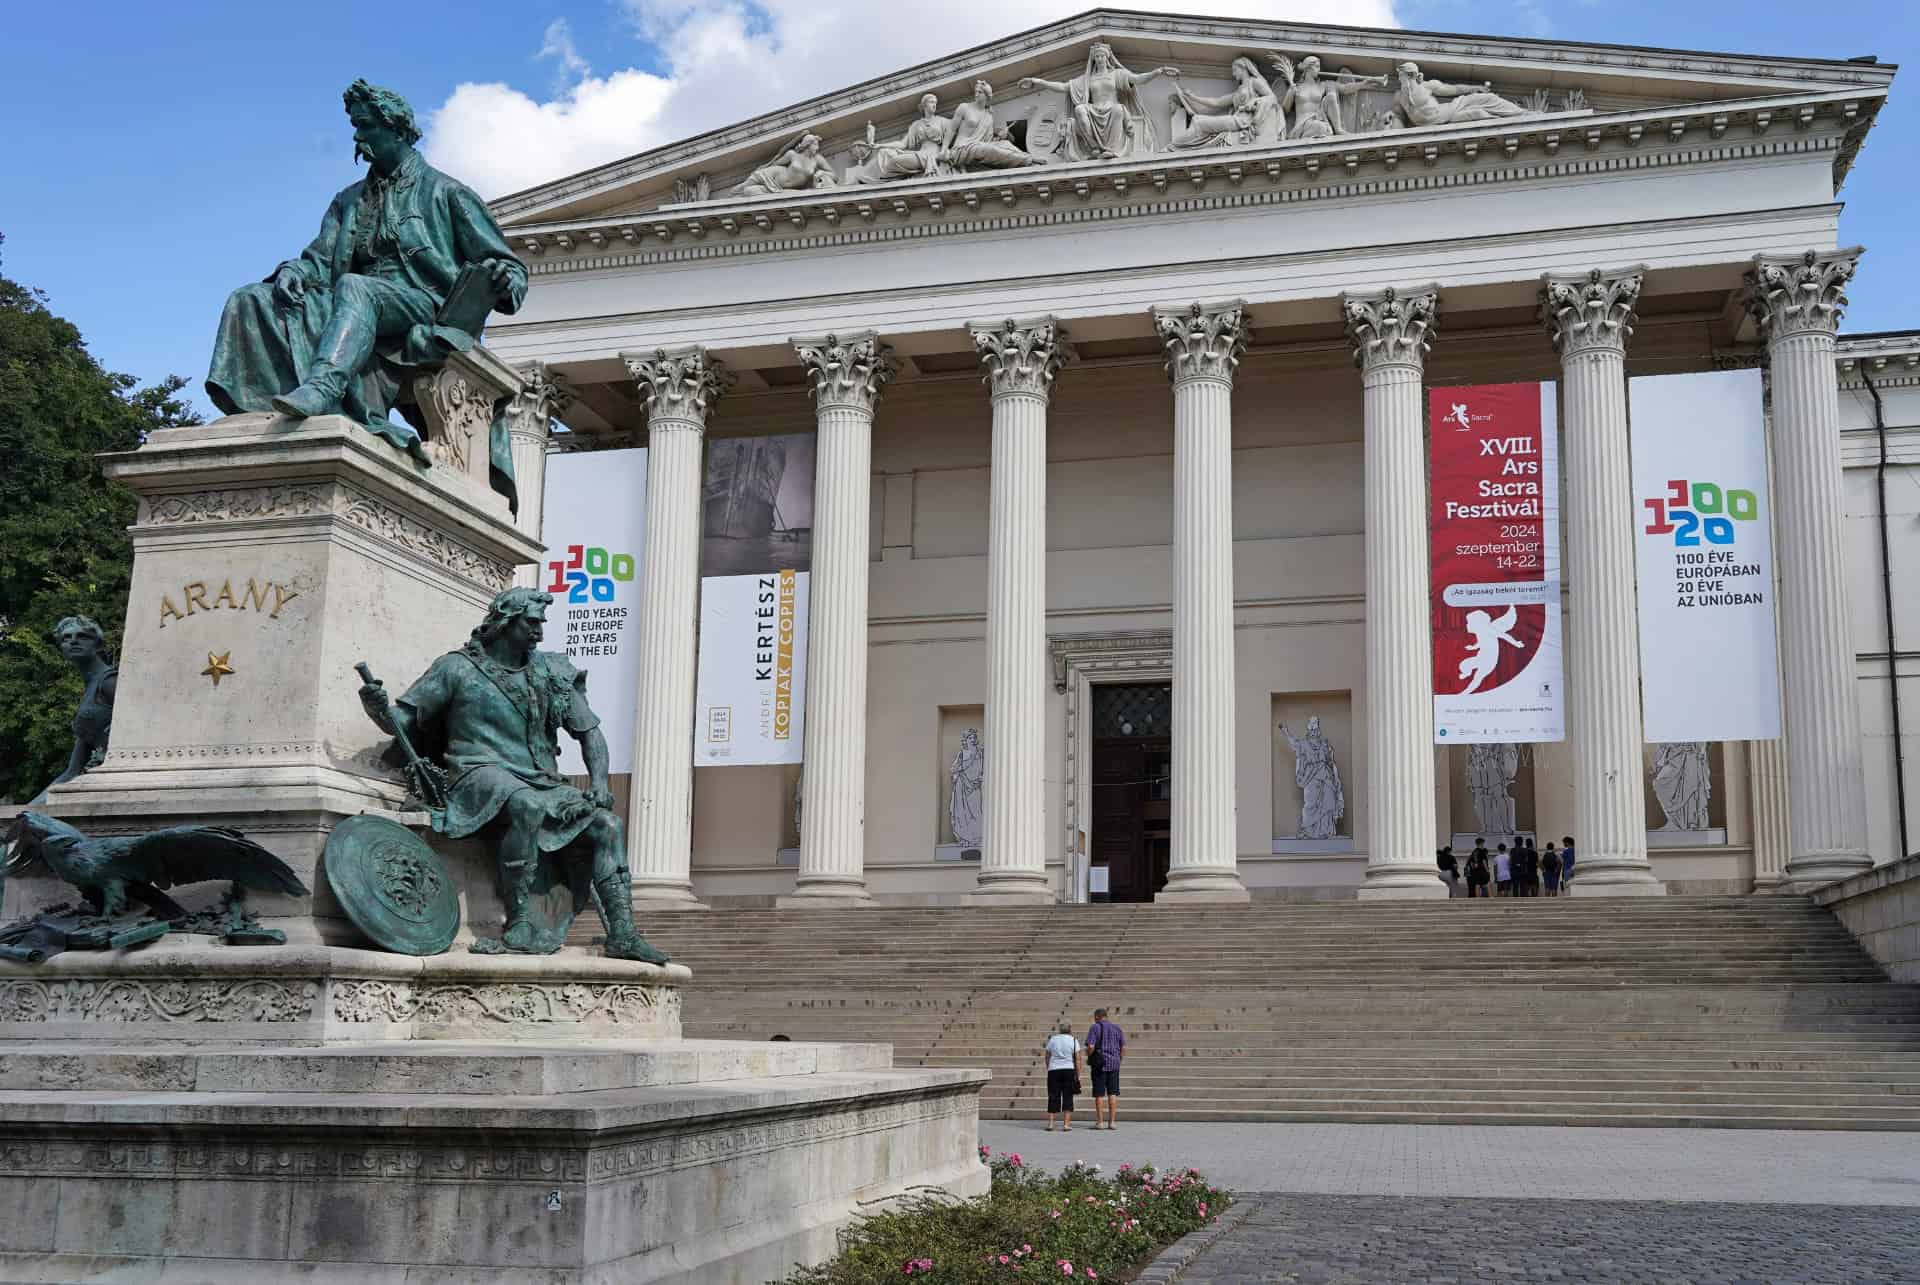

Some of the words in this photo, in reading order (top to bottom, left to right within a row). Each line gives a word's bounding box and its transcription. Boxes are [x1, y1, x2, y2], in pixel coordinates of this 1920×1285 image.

[1480, 436, 1537, 456] XVIII.
[1502, 458, 1537, 475] Ars
[1479, 480, 1538, 497] Sacra
[1446, 499, 1539, 519] Fesztivál
[1669, 510, 1735, 547] 20
[1456, 541, 1539, 556] szeptember
[1676, 553, 1704, 565] 1100
[1708, 550, 1734, 562] ÉVE
[1676, 564, 1761, 579] EURÓPÁBAN
[567, 571, 615, 604] 20
[1677, 582, 1694, 593] 20
[1698, 579, 1724, 592] ÉVE
[159, 576, 299, 628] ARANY
[1677, 597, 1695, 607] AZ
[1699, 592, 1763, 606] UNIÓBAN
[569, 609, 589, 620] 1100
[593, 608, 627, 618] YEARS
[780, 576, 794, 645] COPIES
[567, 623, 578, 632] IN
[581, 620, 624, 631] EUROPE
[755, 578, 775, 680] KERTÉSZ
[566, 635, 579, 644] 20
[582, 633, 617, 643] YEARS
[566, 647, 577, 657] IN
[580, 646, 600, 656] THE
[603, 645, 617, 655] EU
[775, 666, 791, 738] KOPIAK
